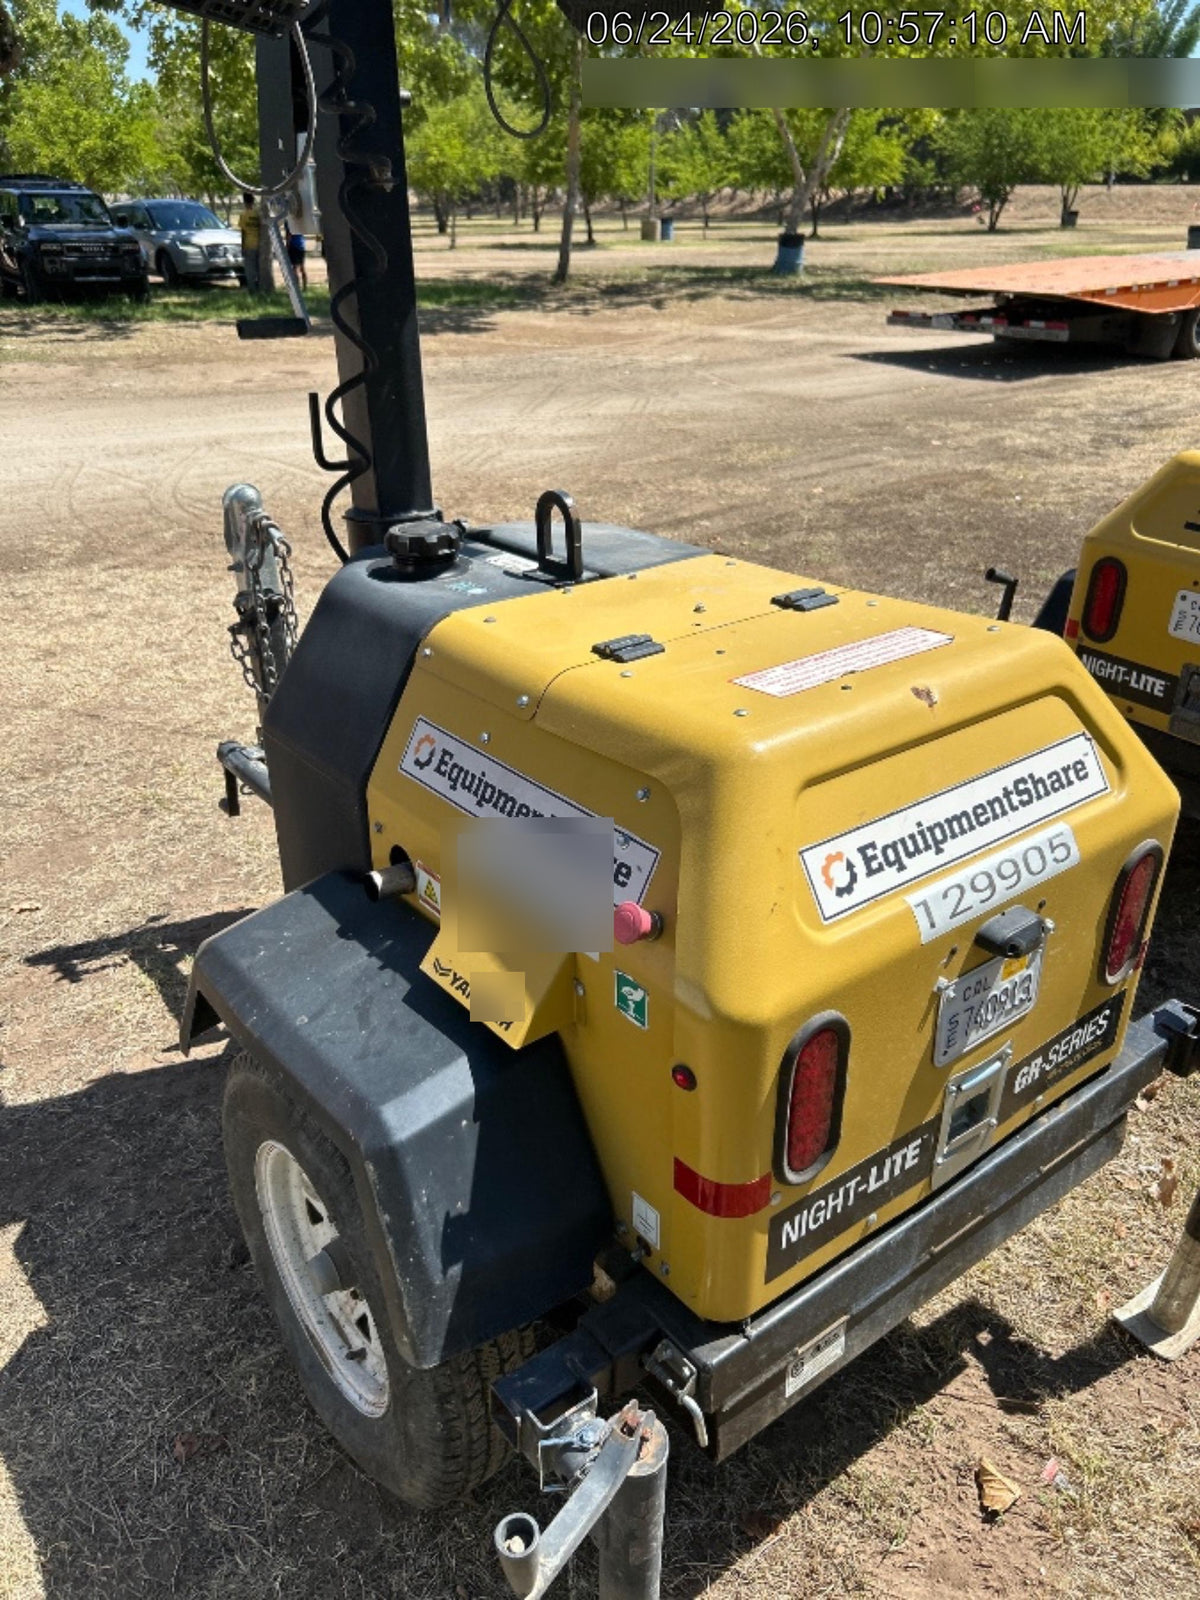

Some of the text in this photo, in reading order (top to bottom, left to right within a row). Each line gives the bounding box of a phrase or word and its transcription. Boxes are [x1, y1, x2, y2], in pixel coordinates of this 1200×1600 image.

[1080, 653, 1166, 698] NIGHT-LITE
[857, 756, 1090, 878] EquipmentShare
[914, 831, 1072, 930] 129905
[1014, 1009, 1111, 1094] GR-SERIES
[781, 1138, 922, 1249] NIGHT-LITE
